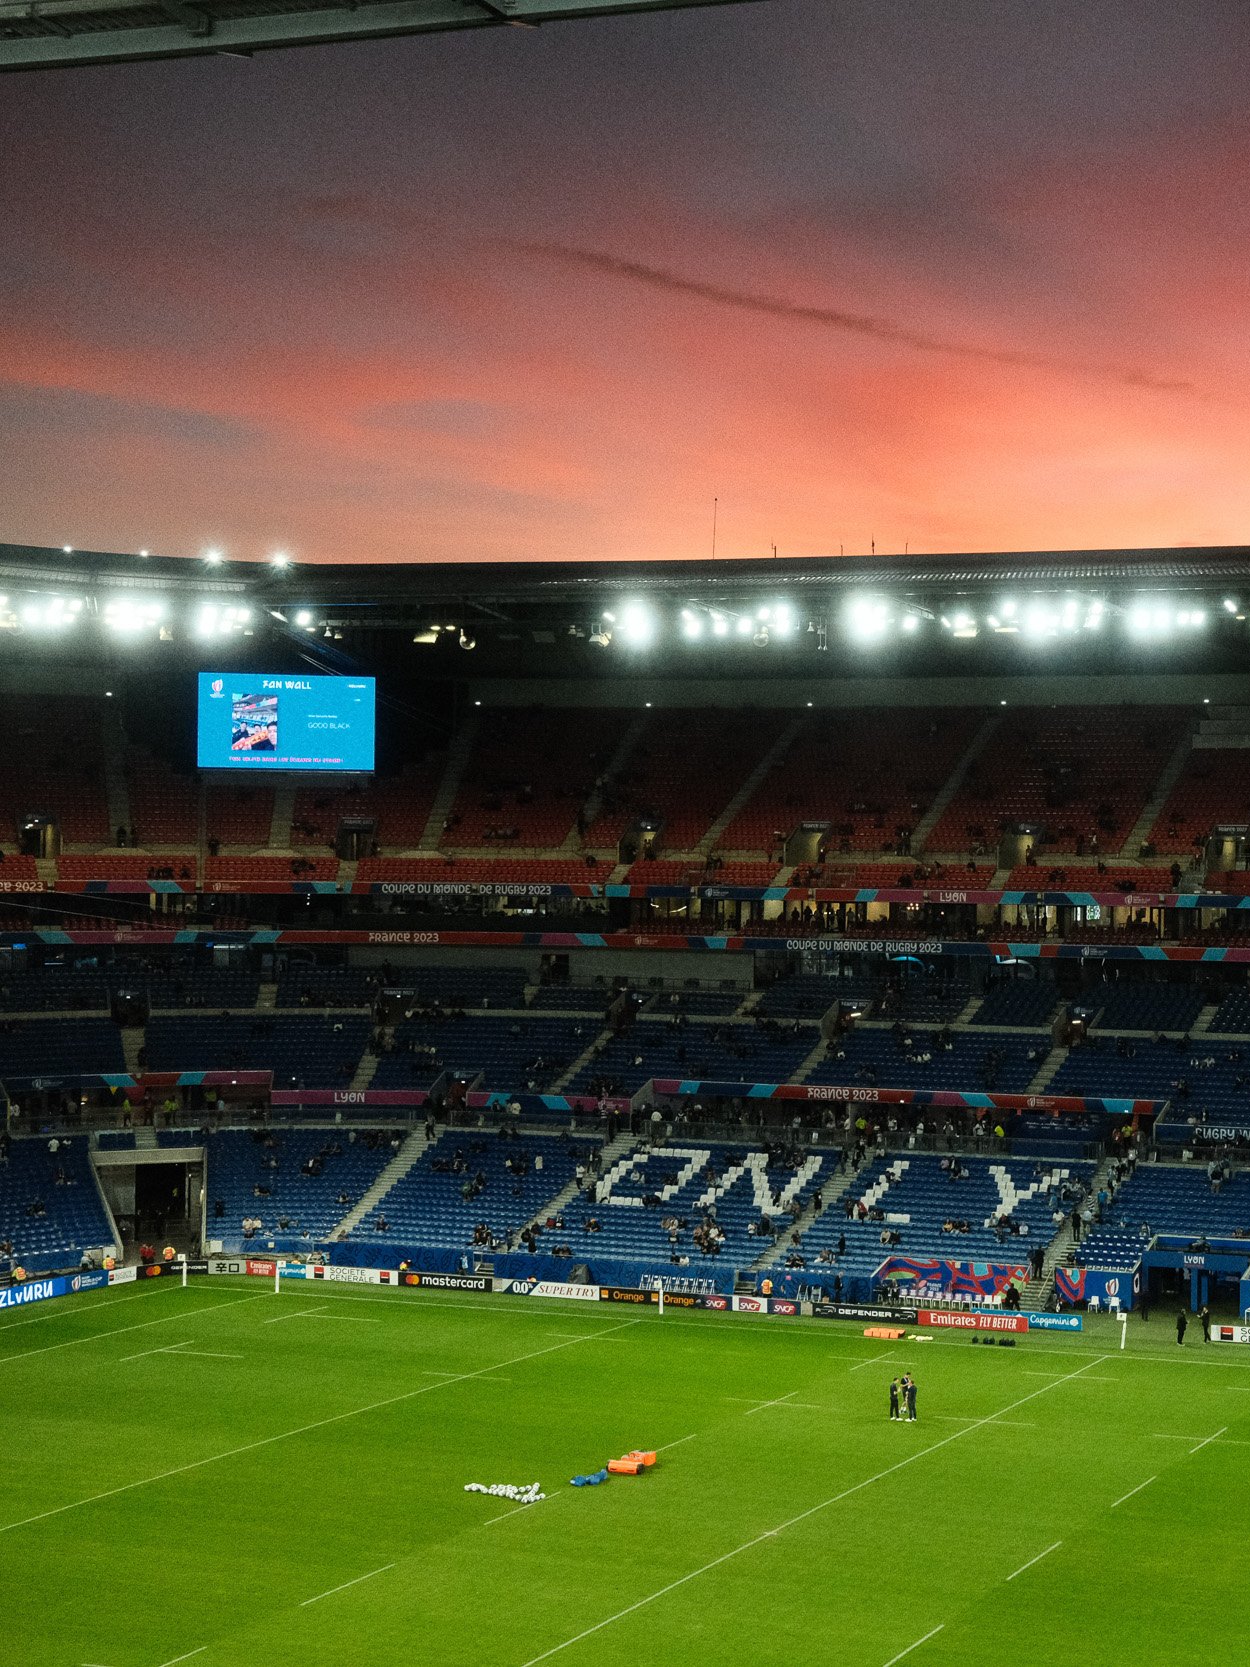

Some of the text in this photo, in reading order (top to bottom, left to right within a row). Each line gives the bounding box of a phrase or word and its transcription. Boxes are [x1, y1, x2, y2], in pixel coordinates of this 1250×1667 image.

[263, 680, 312, 690] FAN WALL
[15, 881, 44, 892] 2023
[417, 884, 431, 894] DU
[495, 884, 527, 896] RUGBY
[528, 884, 551, 896] 2023
[940, 891, 967, 903] LYON
[414, 932, 439, 943] 2023
[819, 940, 832, 951] DU
[886, 942, 917, 953] RUGBY
[918, 942, 942, 954] 2023
[334, 1091, 365, 1103] LYON
[807, 1087, 879, 1101] FRANCE 2023
[1184, 1255, 1205, 1265] LYON
[216, 1262, 239, 1273] 辛口
[422, 1275, 485, 1289] mastercard
[538, 1284, 597, 1298] SUPER TRY
[613, 1291, 644, 1302] Orange
[663, 1294, 694, 1306] Orange
[705, 1300, 726, 1308] SNCF
[739, 1302, 760, 1311] SNCF
[773, 1304, 795, 1313] SNCF
[838, 1308, 892, 1317] DEFENDER
[930, 1312, 976, 1326] Emirates
[979, 1315, 992, 1328] FLY
[992, 1316, 1017, 1330] BETTER
[1029, 1314, 1070, 1328] Capgemini
